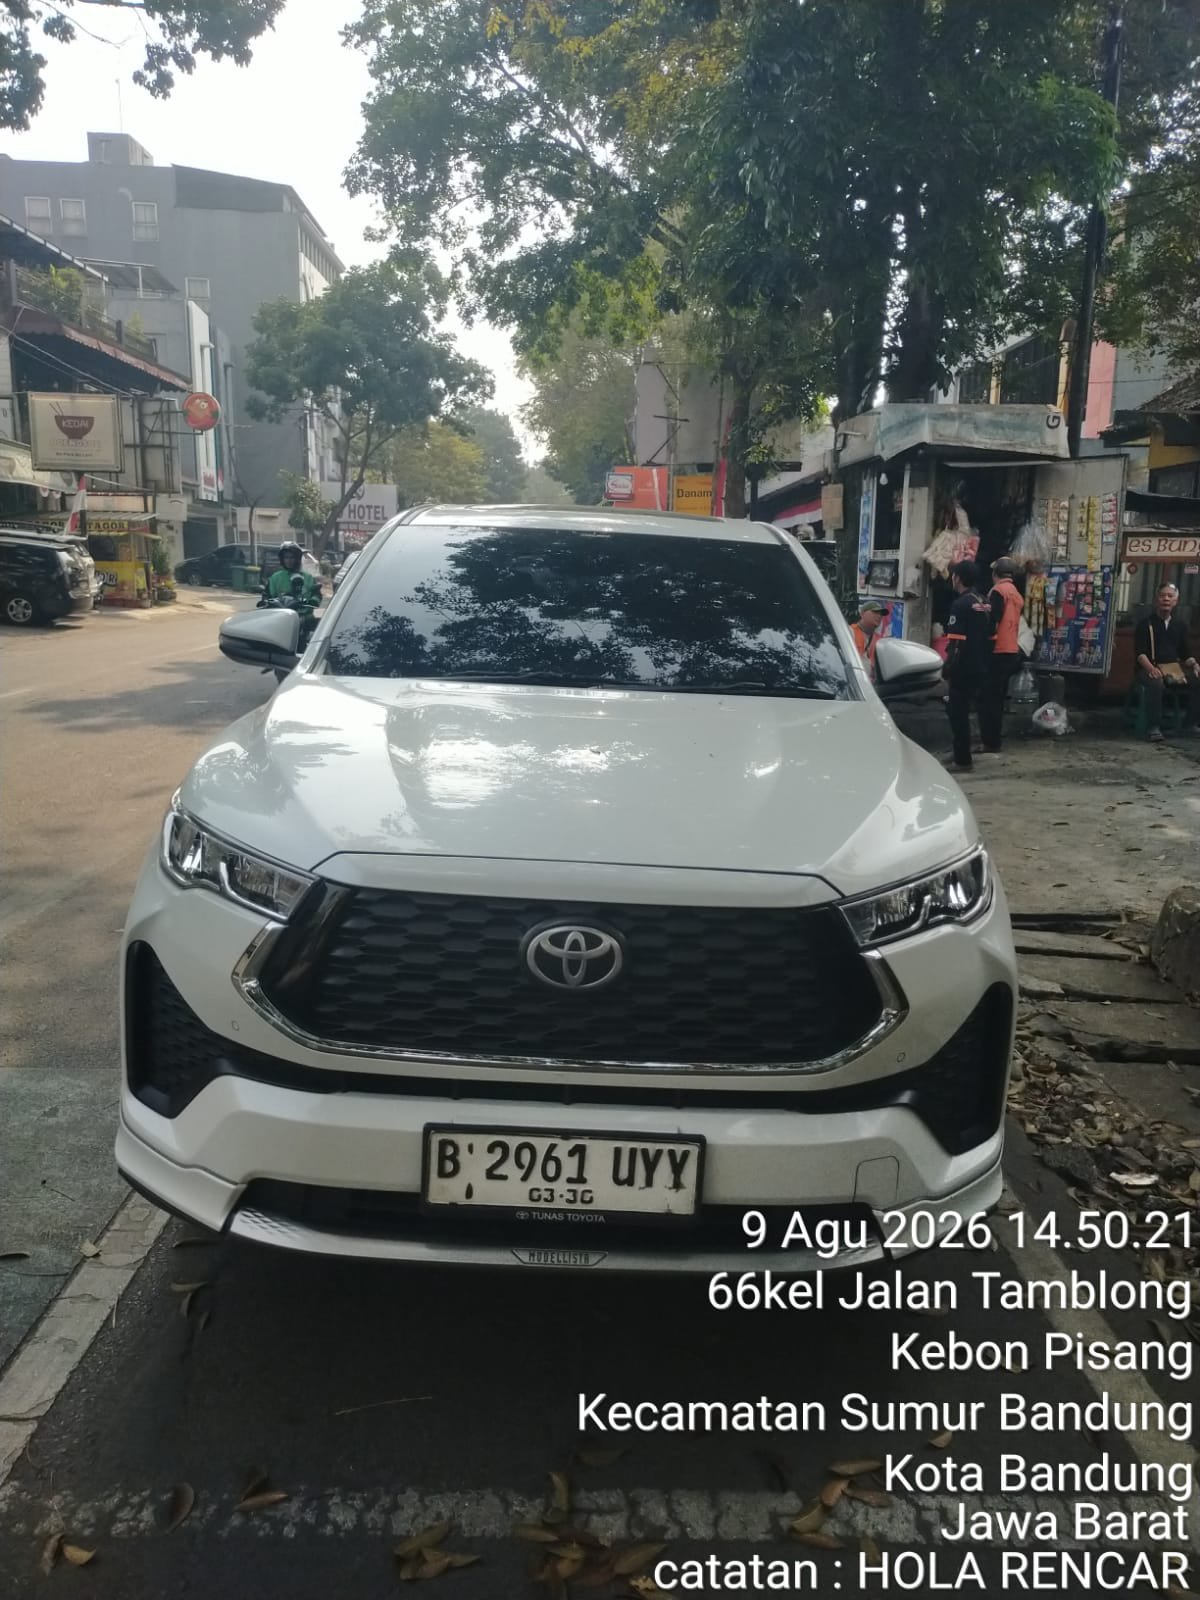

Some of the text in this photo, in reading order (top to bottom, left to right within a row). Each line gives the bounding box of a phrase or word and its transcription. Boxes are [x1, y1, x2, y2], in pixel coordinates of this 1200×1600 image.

[348, 503, 388, 521] HOTEL
[436, 1138, 691, 1189] B 2961 UYY
[531, 1210, 606, 1223] TUNAS TOYOTA
